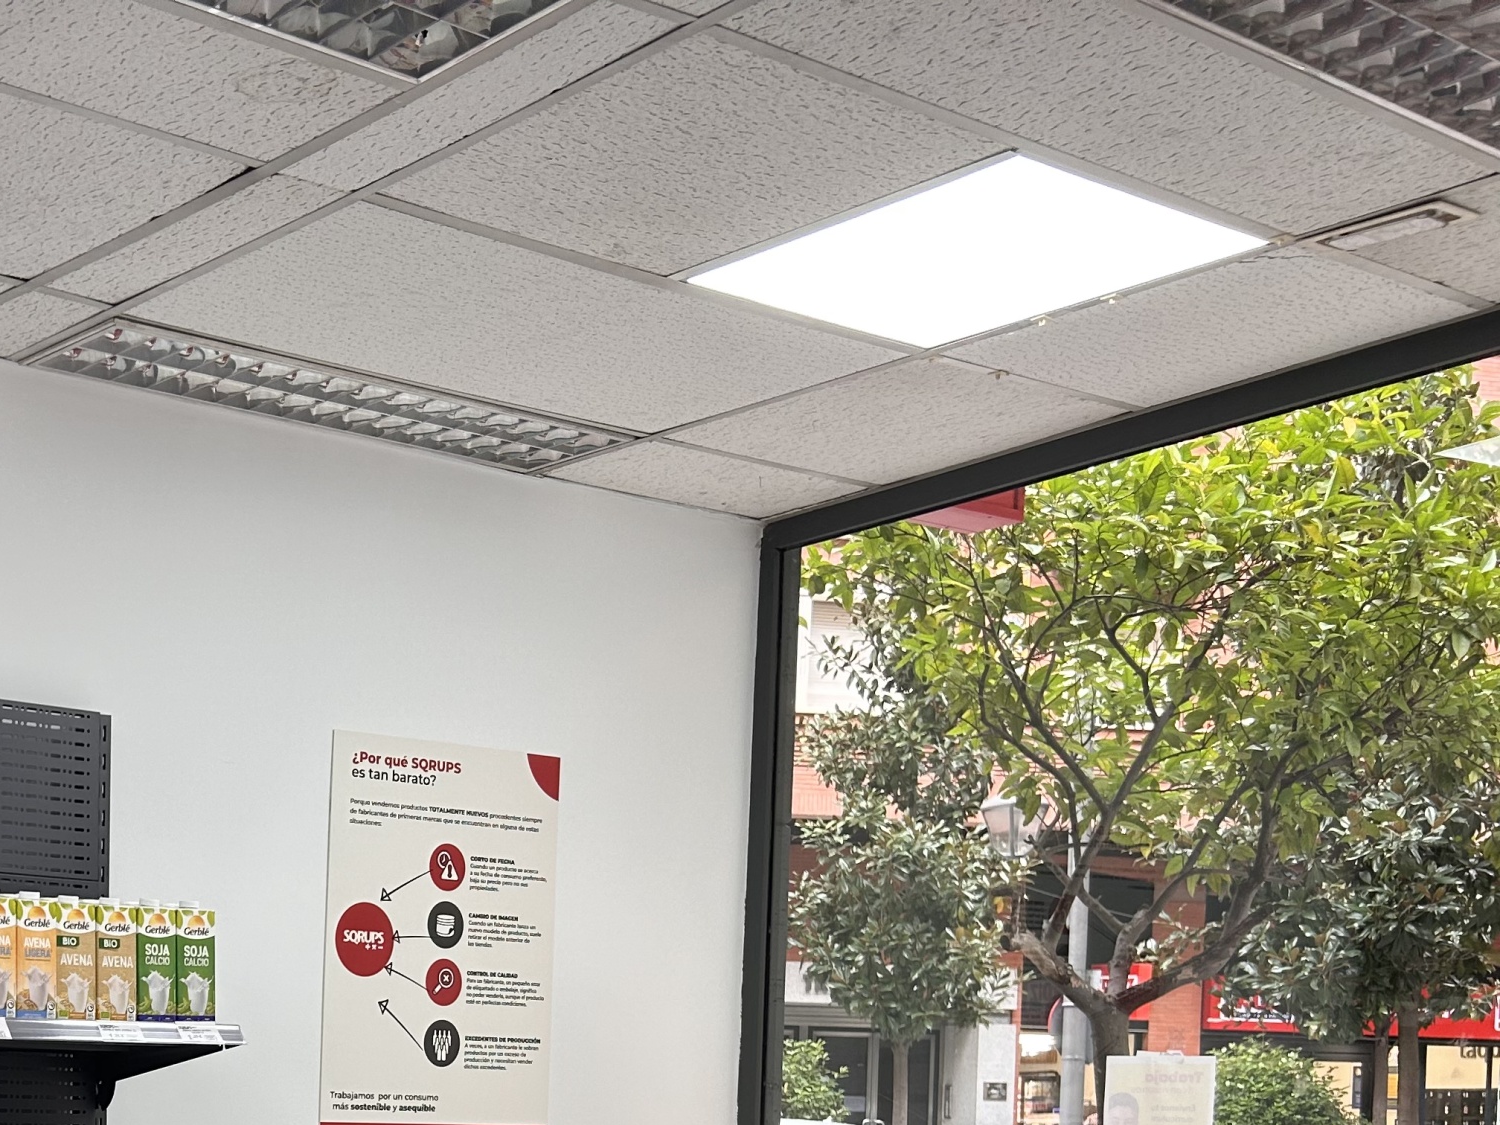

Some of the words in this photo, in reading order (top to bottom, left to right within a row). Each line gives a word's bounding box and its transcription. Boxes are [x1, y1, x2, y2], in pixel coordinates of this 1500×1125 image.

[352, 751, 381, 766] ¿Por
[384, 754, 408, 770] qué
[411, 757, 462, 774] SQRUPS
[352, 768, 366, 778] es
[368, 768, 389, 781] tan
[392, 768, 437, 787] barato?
[429, 806, 465, 815] TOTALMENTE
[184, 926, 210, 937] Gerblé
[343, 929, 384, 945] SQRUPS
[184, 945, 209, 958] SOJA
[184, 957, 209, 967] CALCIO
[330, 1091, 375, 1102] Trabajamos
[378, 1093, 391, 1103] por
[393, 1093, 403, 1101] un
[404, 1093, 439, 1102] consumo
[332, 1102, 349, 1111] más
[350, 1103, 391, 1112] sostenible
[392, 1105, 398, 1113] y
[399, 1104, 436, 1114] asequible
